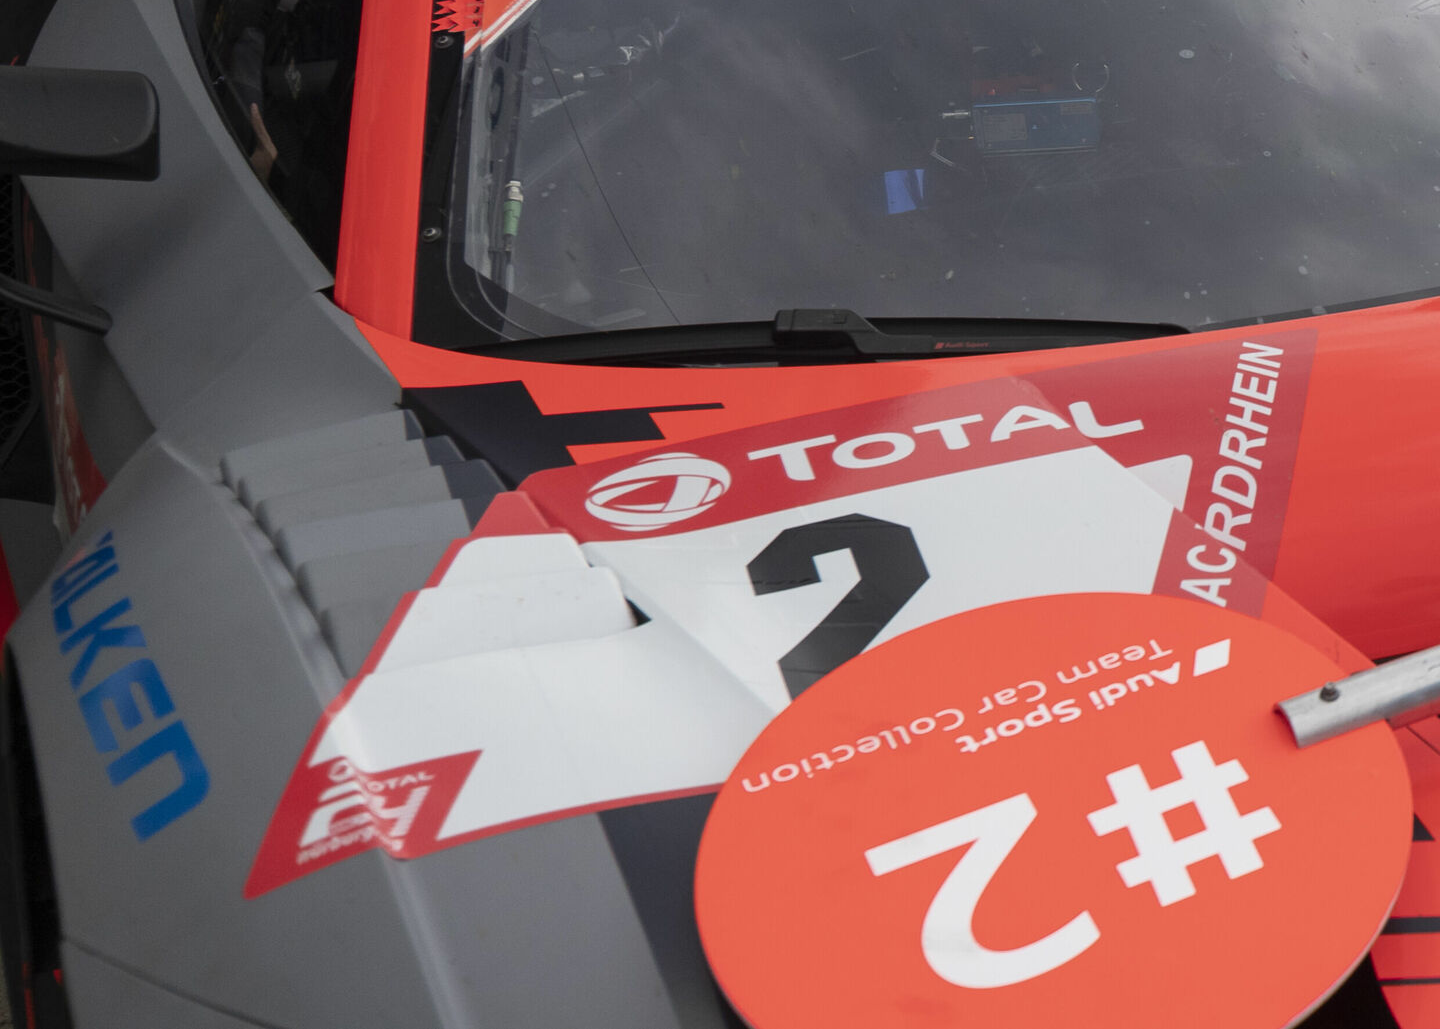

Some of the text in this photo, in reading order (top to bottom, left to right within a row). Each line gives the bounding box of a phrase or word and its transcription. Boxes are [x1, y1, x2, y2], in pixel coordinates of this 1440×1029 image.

[747, 401, 1144, 482] TOTAL
[51, 529, 211, 844] ALKEN
[745, 513, 931, 703] 2
[741, 638, 1174, 793] Team Car Collection
[955, 662, 1181, 754] Audi Sport
[863, 740, 1283, 991] #2
